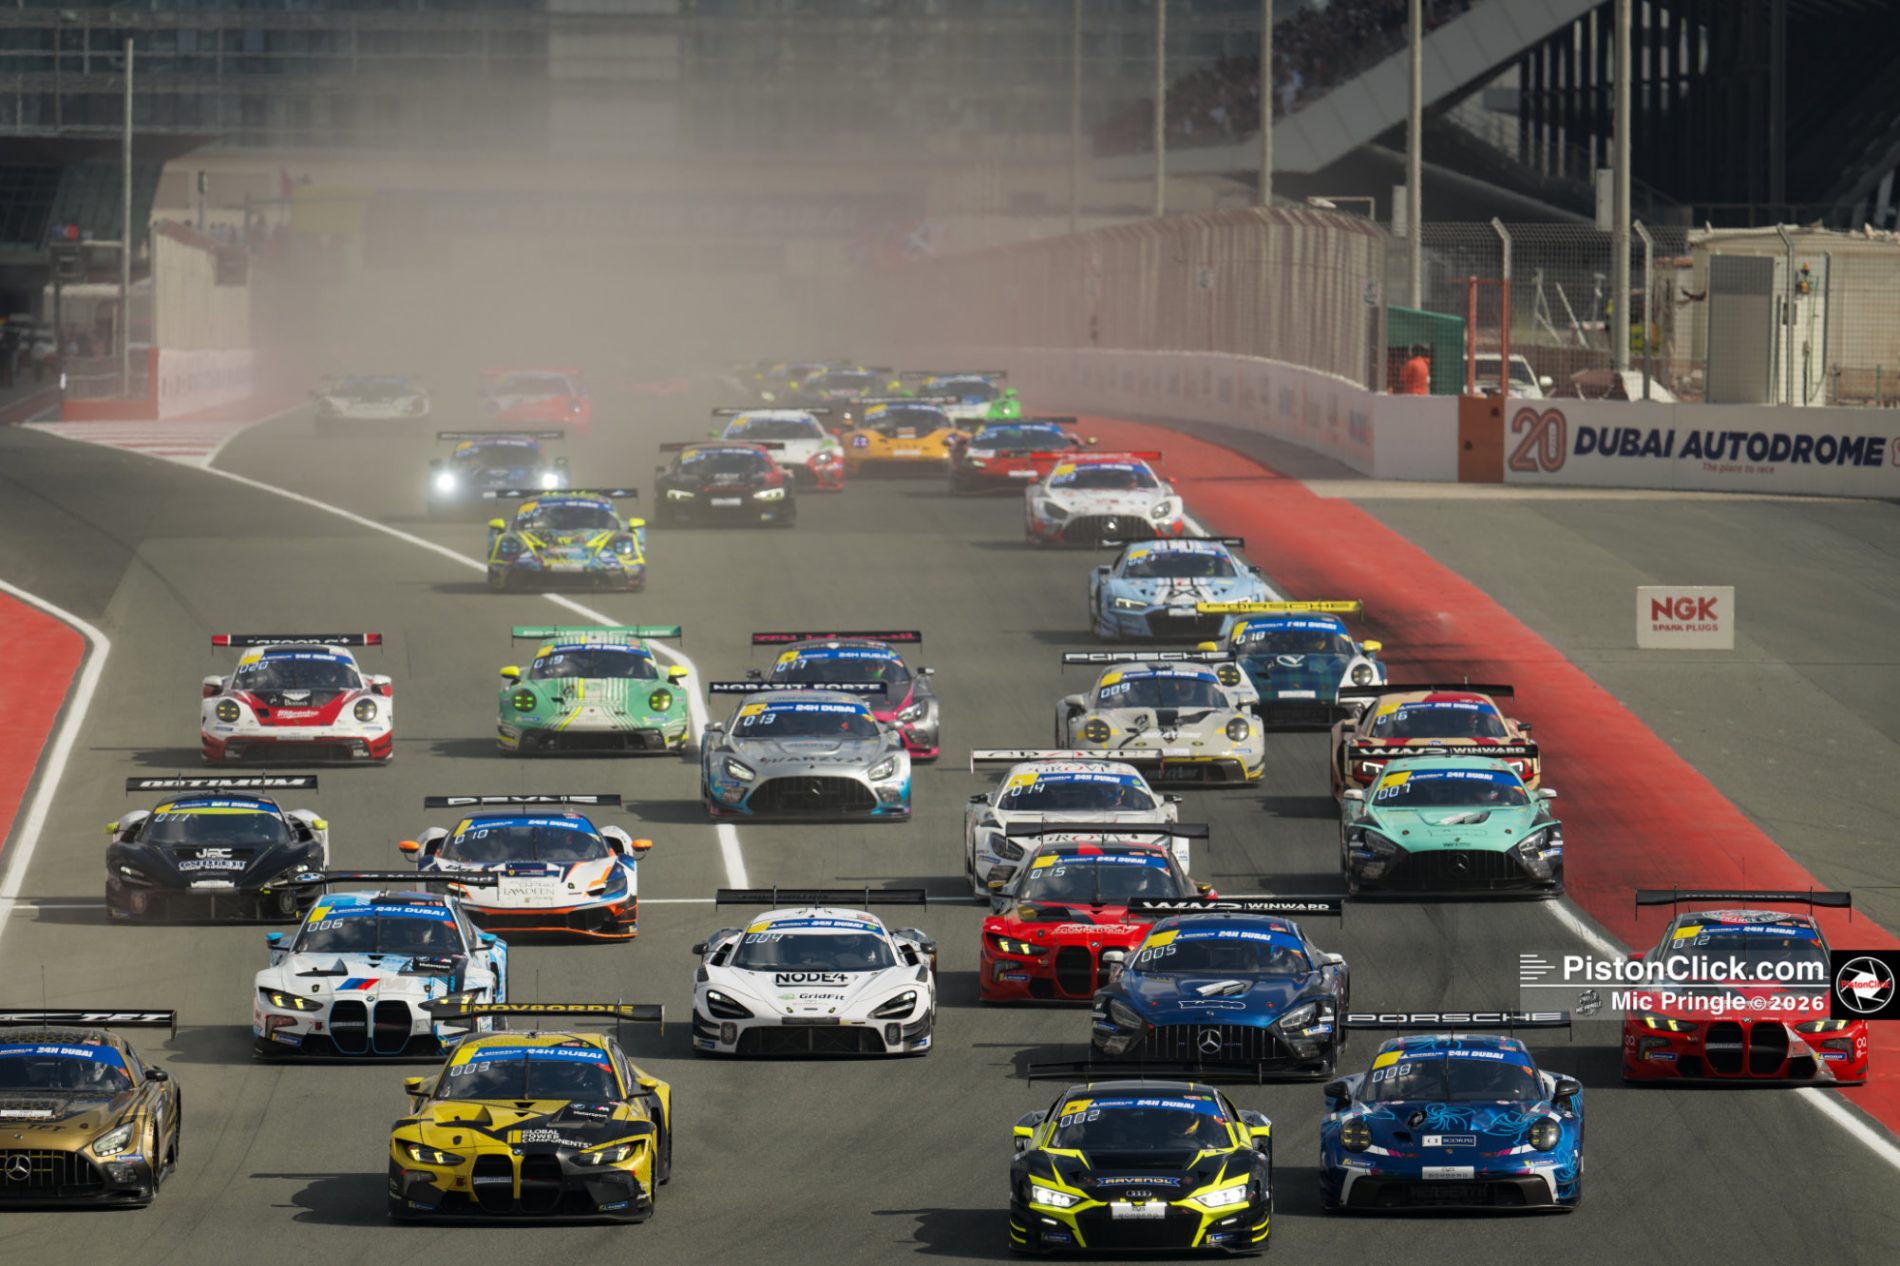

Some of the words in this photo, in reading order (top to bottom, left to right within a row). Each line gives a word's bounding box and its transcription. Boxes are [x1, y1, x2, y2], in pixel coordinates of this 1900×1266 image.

[1507, 406, 1568, 473] 20
[1574, 425, 1676, 459] DUBAI
[1679, 430, 1887, 467] AUTODROME
[1702, 462, 1717, 473] The
[1719, 463, 1742, 476] place
[1745, 465, 1754, 475] to
[1756, 466, 1775, 475] race
[1650, 596, 1719, 621] NGK
[1686, 623, 1719, 632] PLUGS
[1452, 746, 1526, 755] WINWARD
[404, 906, 446, 917] DUBAI
[1247, 902, 1331, 910] WINWARD
[306, 918, 344, 932] 006
[799, 992, 846, 1002] GridFit
[1346, 1011, 1562, 1023] PORSCHE
[36, 1046, 59, 1055] 24H
[61, 1047, 94, 1058] DUBAI
[526, 1048, 555, 1056] 24H
[557, 1049, 603, 1060] DUBAI
[1471, 1050, 1505, 1060] DUBAI
[1372, 1063, 1411, 1083] 008
[1161, 1100, 1196, 1110] DUBAI
[1059, 1109, 1101, 1128] 002
